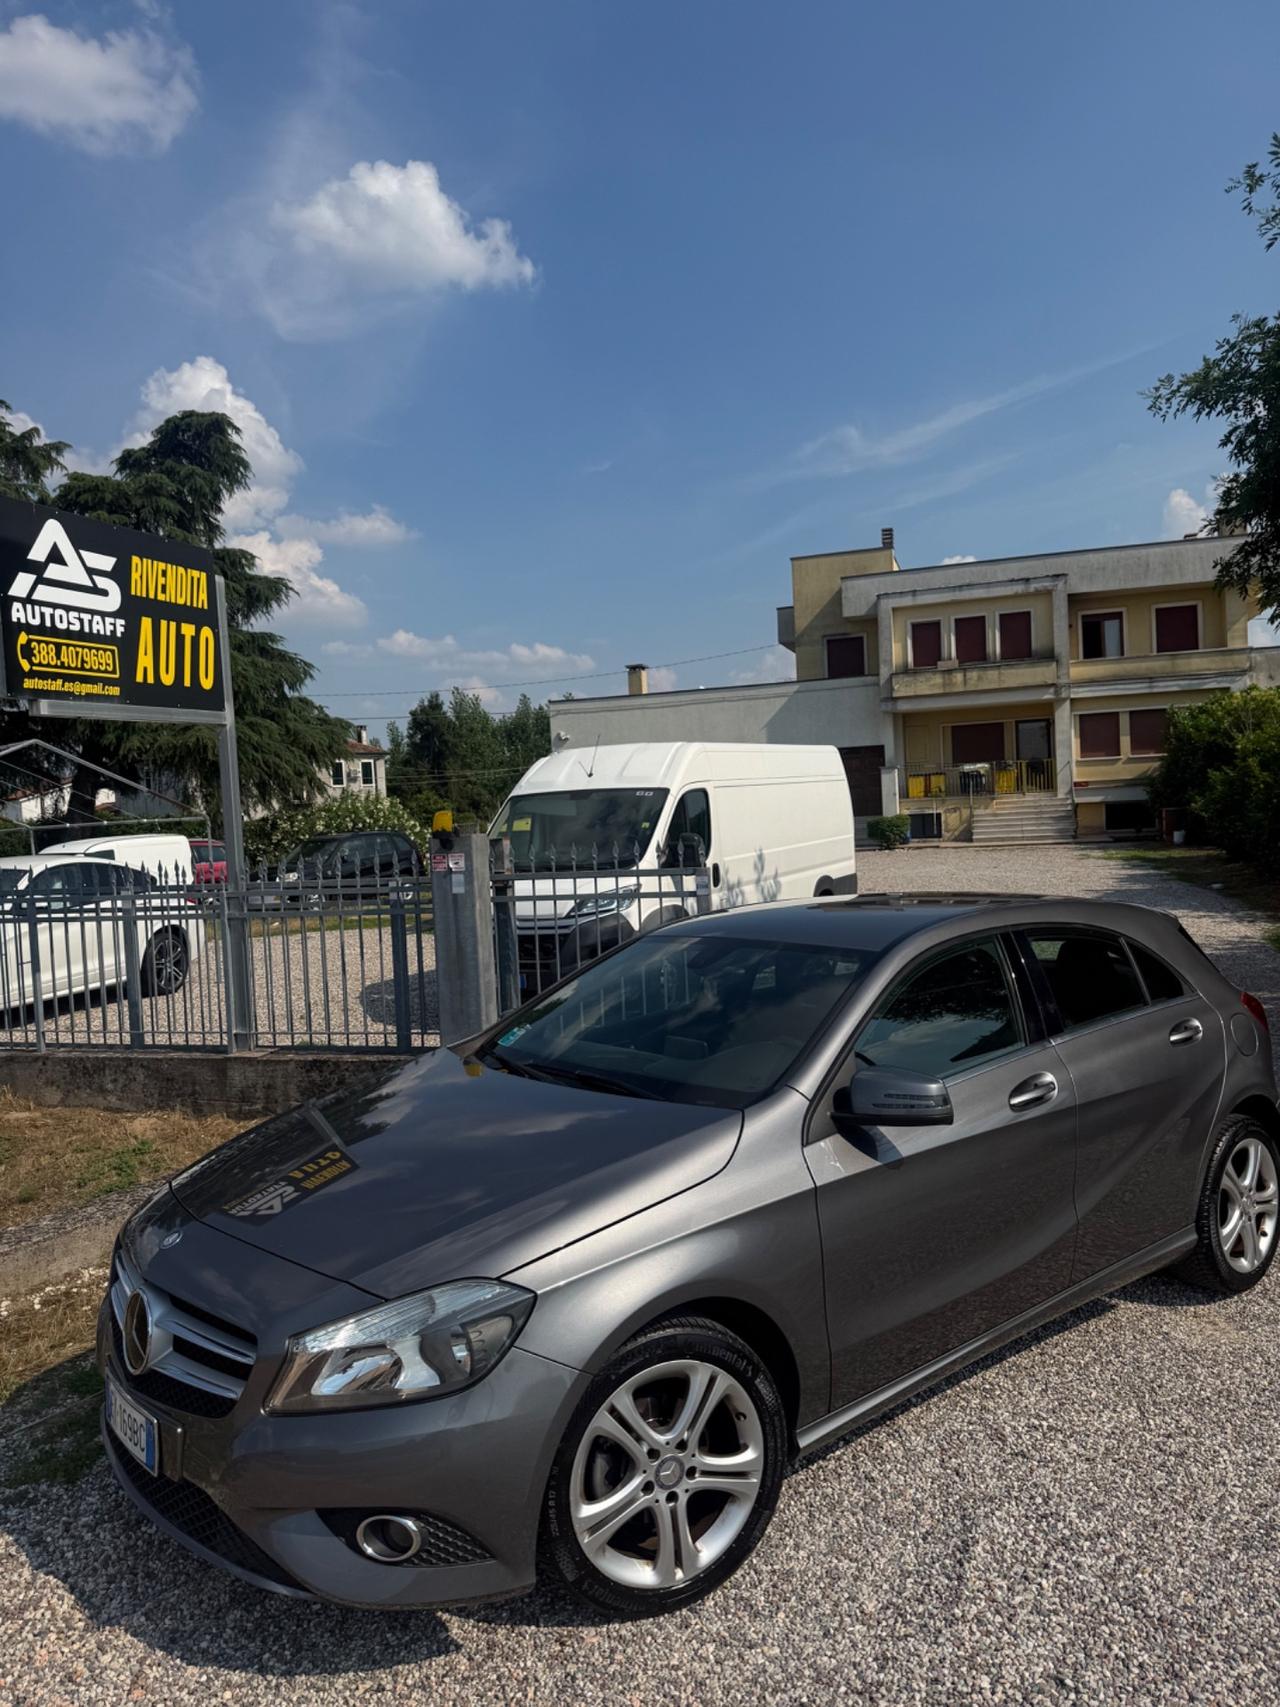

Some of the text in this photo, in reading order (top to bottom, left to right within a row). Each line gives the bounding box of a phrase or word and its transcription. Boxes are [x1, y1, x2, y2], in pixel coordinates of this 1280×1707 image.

[130, 555, 208, 610] RIVENDITA
[11, 602, 125, 637] AUTOSTAFF
[31, 642, 113, 671] 388.4079699
[135, 616, 215, 691] AUTO
[23, 677, 120, 696] autostaff.es@gmail.com
